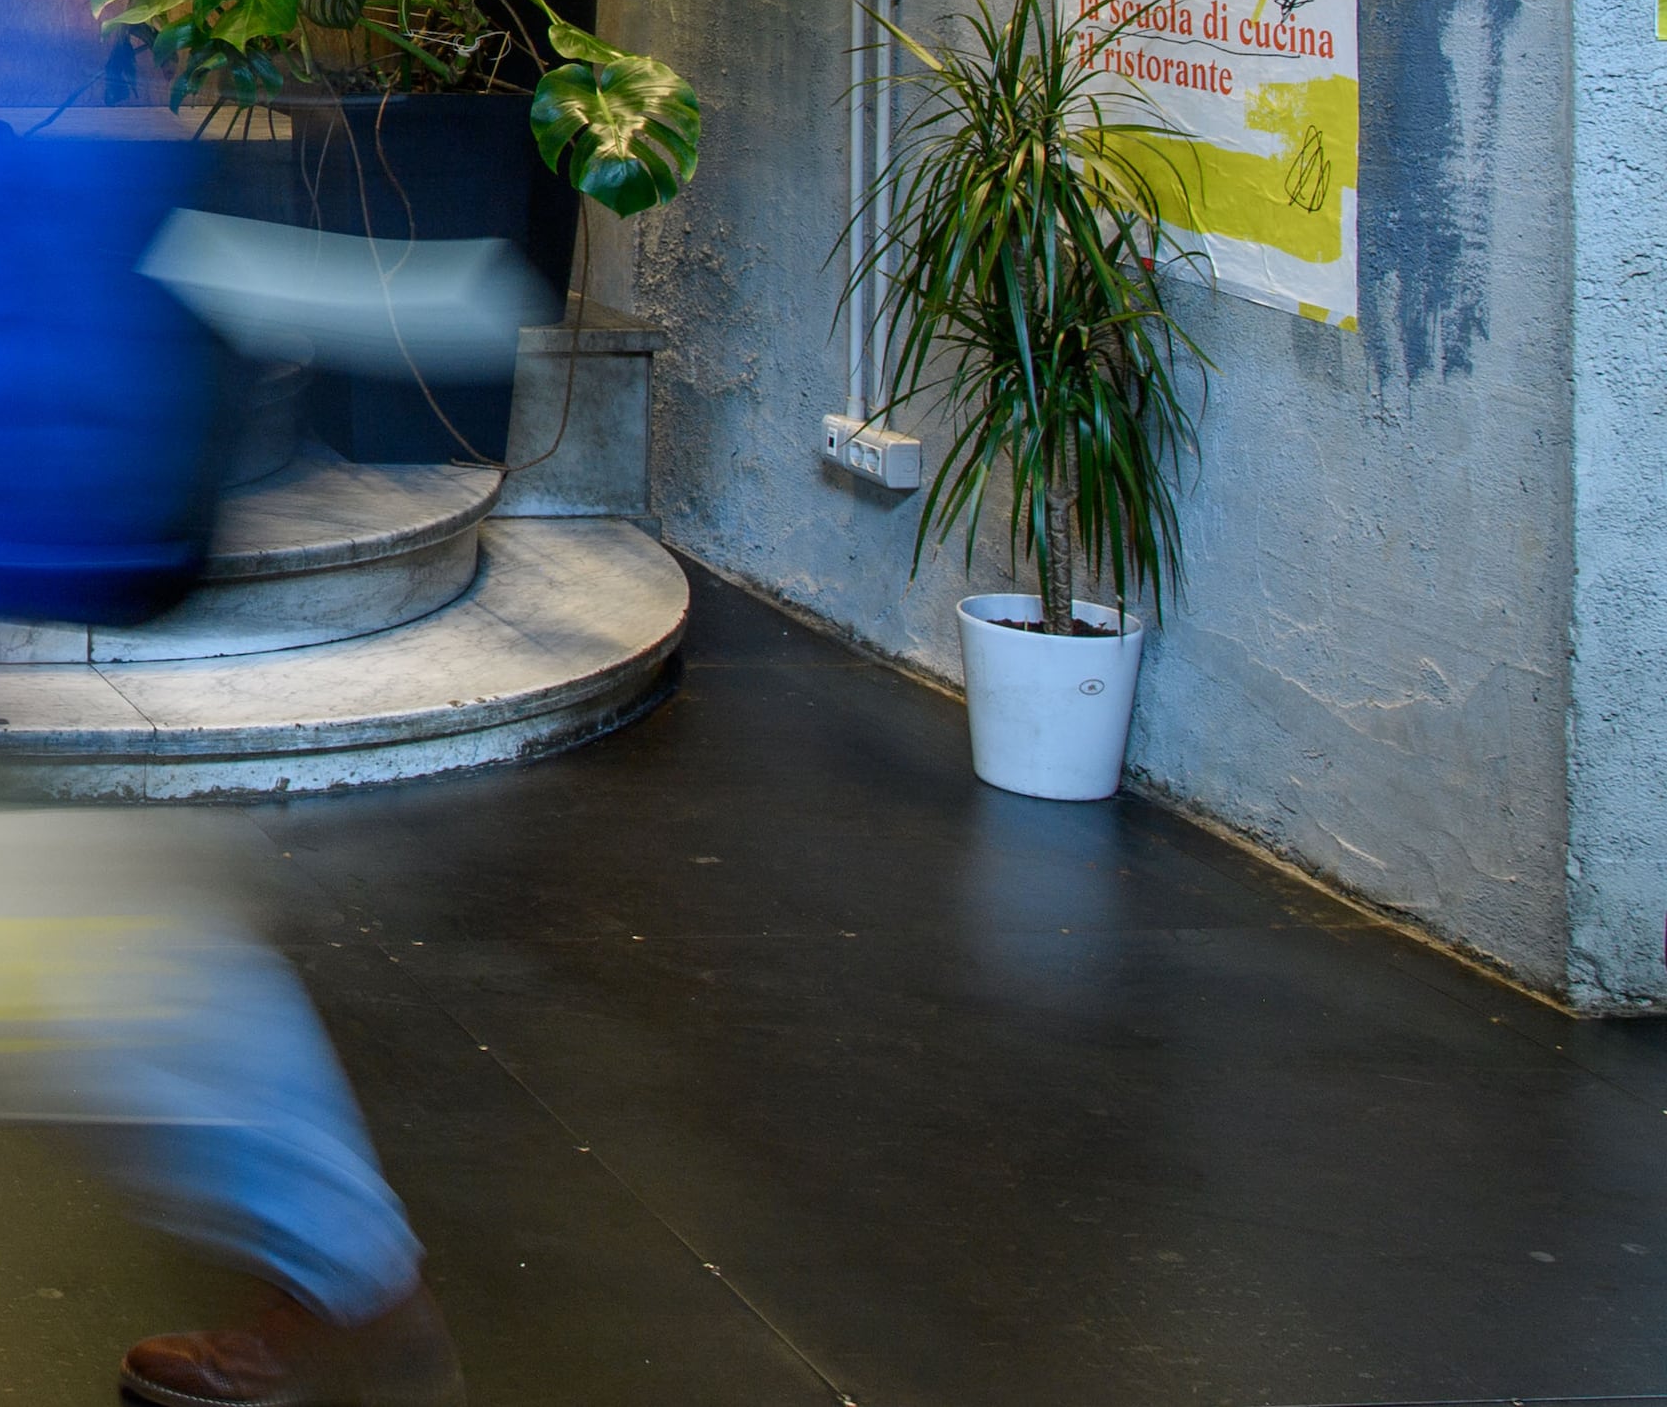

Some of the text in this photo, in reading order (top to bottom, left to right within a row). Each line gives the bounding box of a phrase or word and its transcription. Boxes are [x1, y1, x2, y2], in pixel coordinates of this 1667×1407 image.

[1202, 0, 1229, 42] di
[1238, 14, 1335, 60] cucina
[1077, 30, 1234, 96] il ristorante
